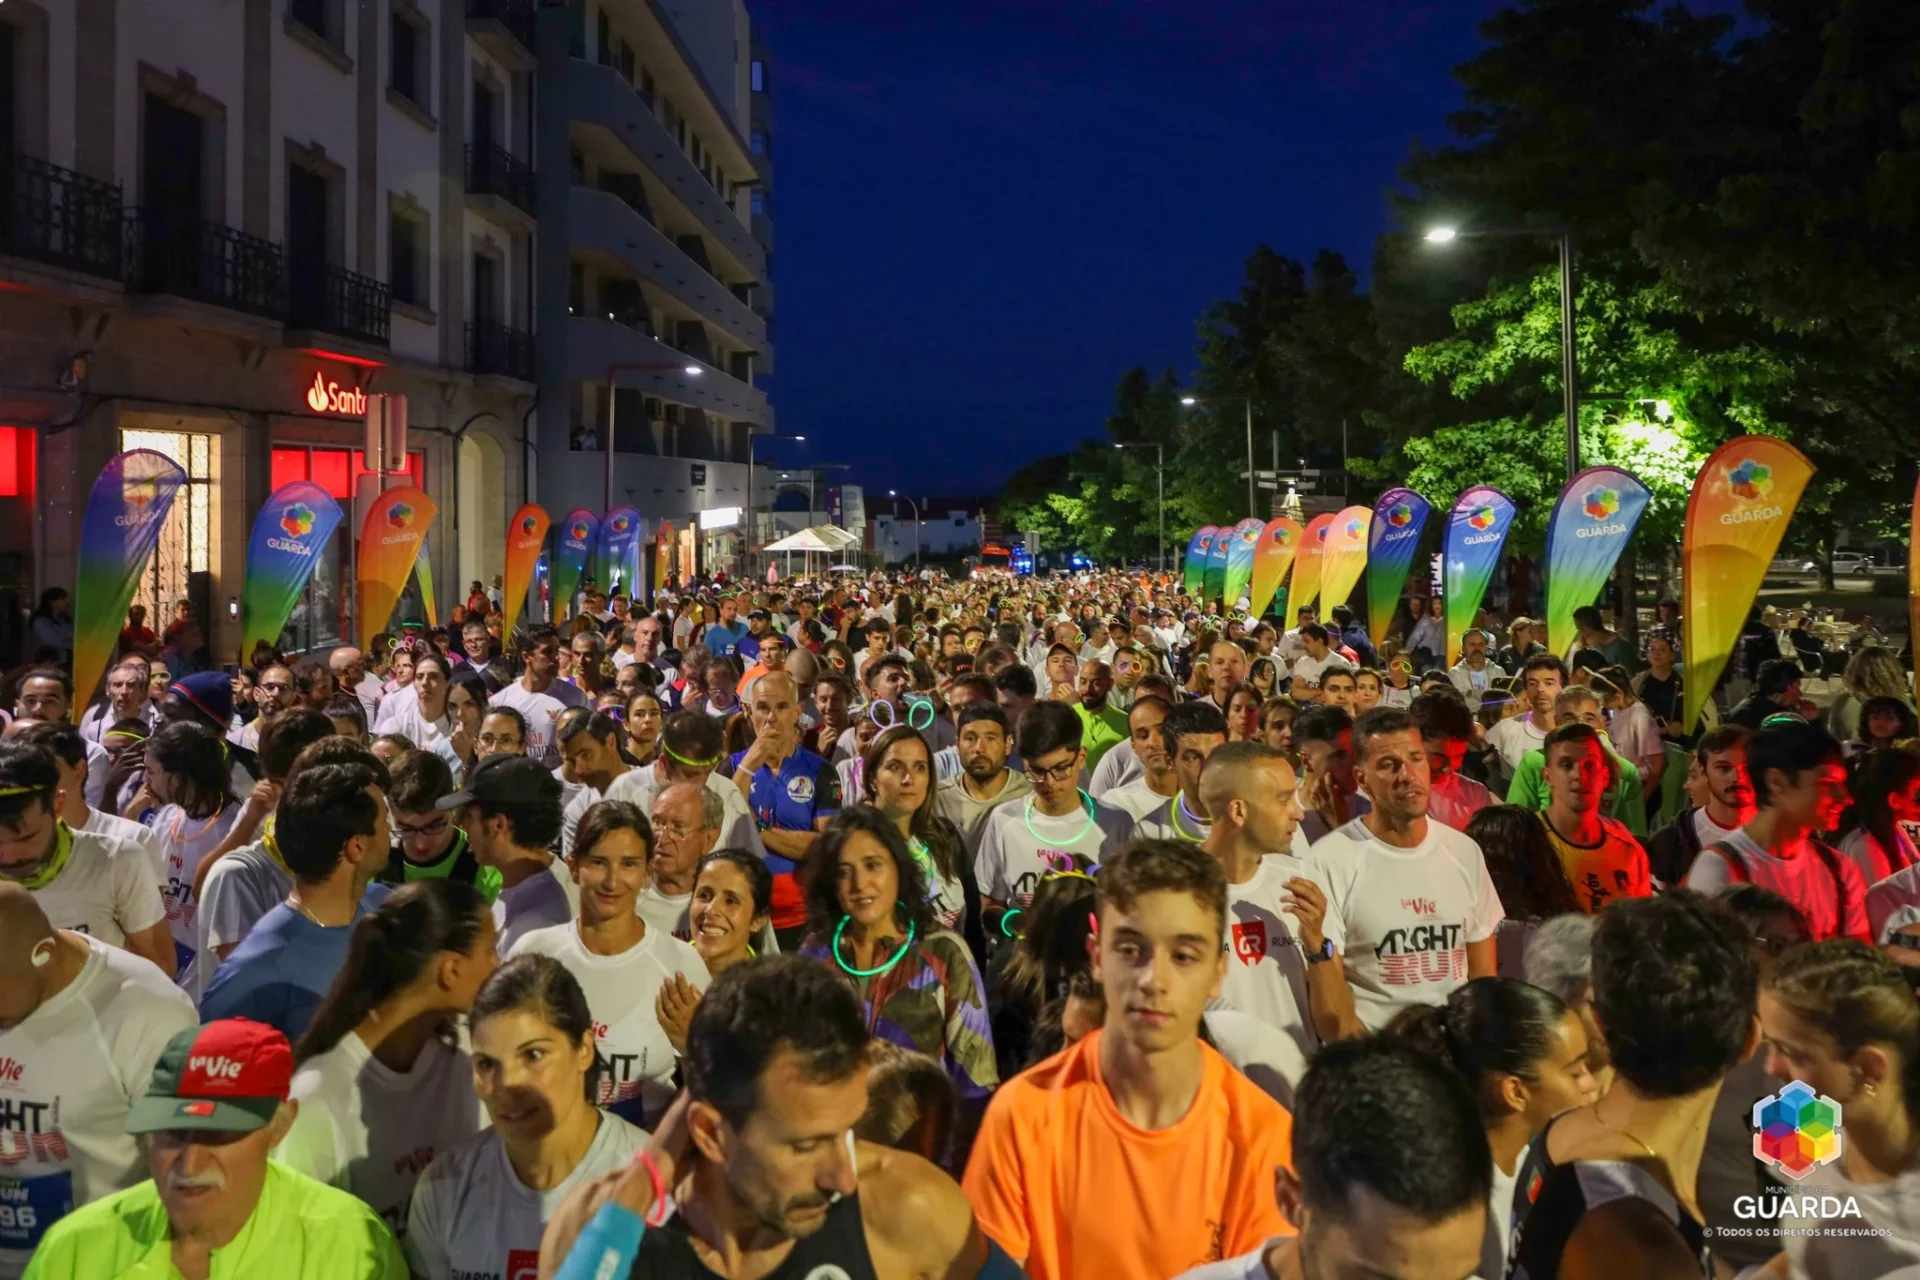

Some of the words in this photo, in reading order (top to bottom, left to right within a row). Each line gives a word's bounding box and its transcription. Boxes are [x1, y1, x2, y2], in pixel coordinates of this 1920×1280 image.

[1720, 505, 1784, 525] GUARDA
[1575, 523, 1628, 539] GUARDA
[267, 538, 312, 557] GUARDA
